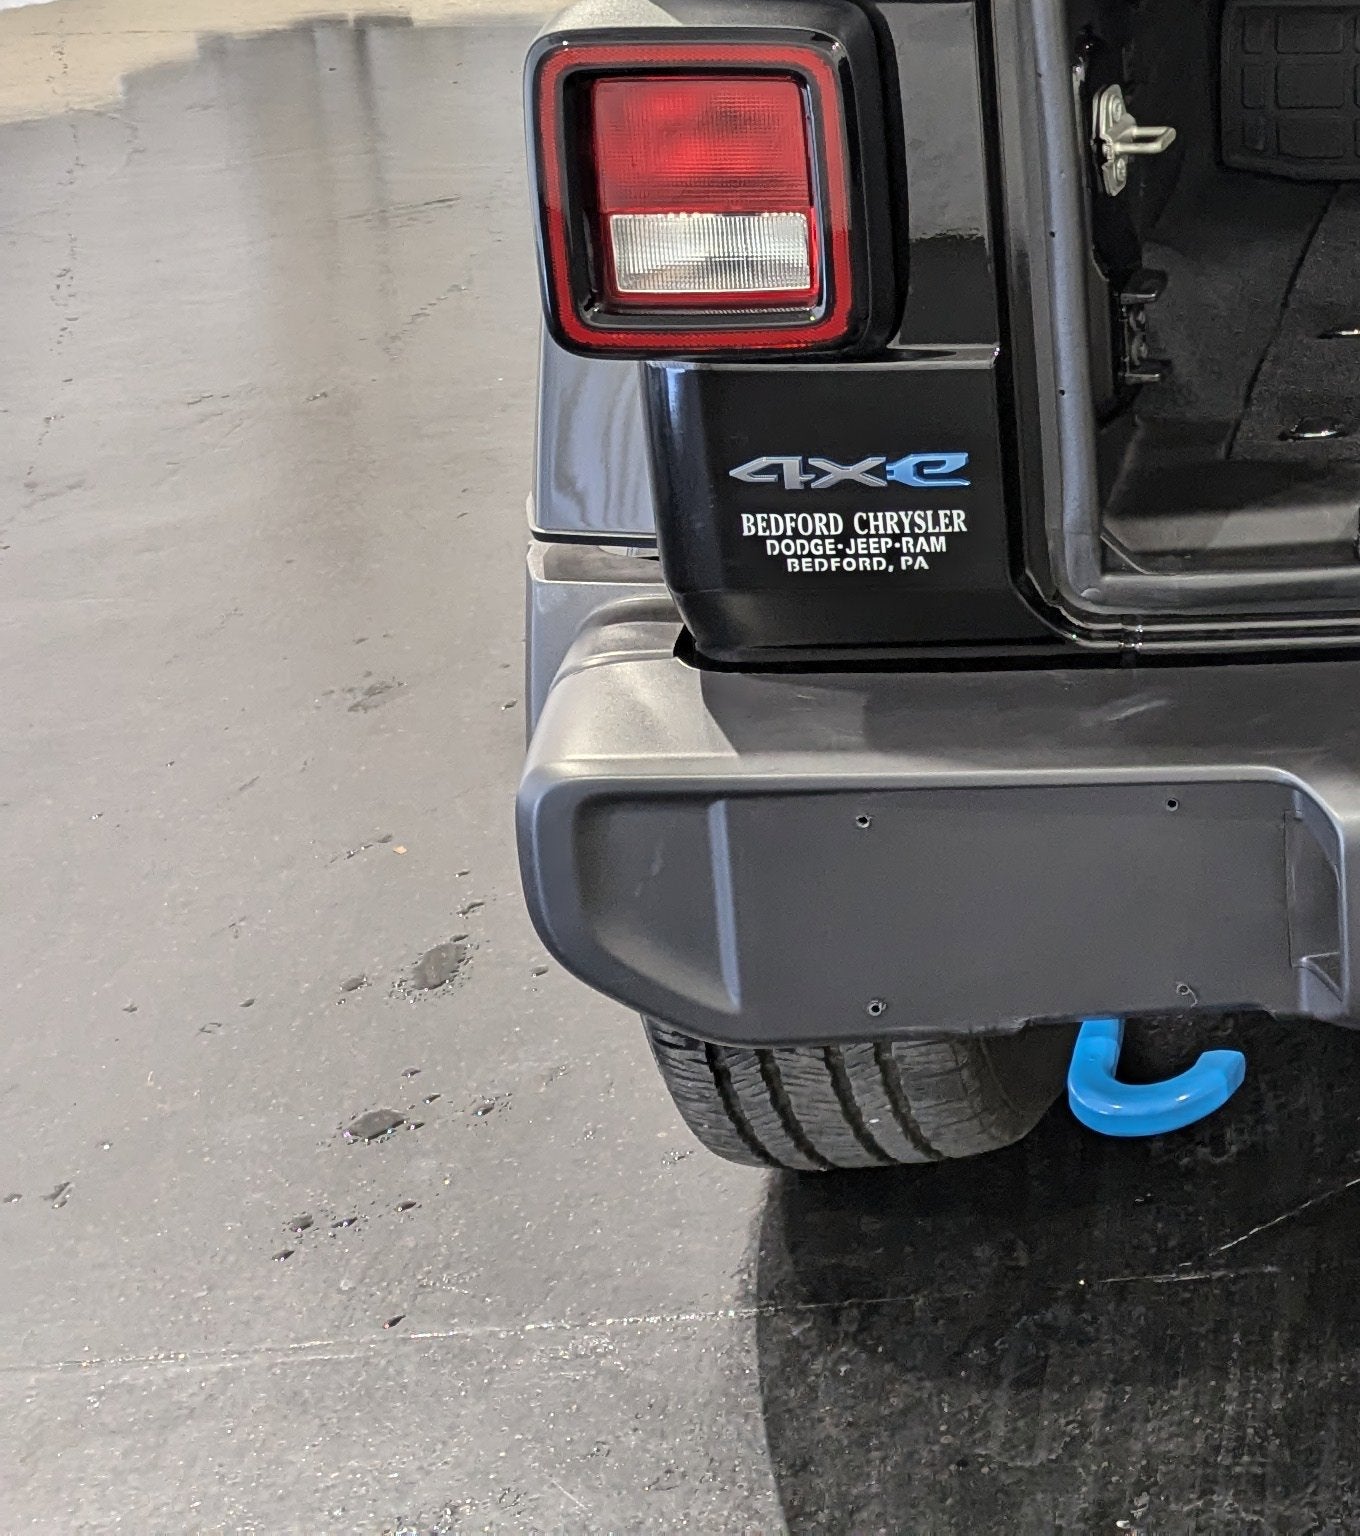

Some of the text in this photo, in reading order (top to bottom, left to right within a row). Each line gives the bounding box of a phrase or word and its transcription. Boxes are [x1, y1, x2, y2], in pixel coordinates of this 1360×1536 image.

[741, 509, 968, 537] BEDFORD CHRYSLER
[787, 556, 930, 573] BEDFORD, PA
